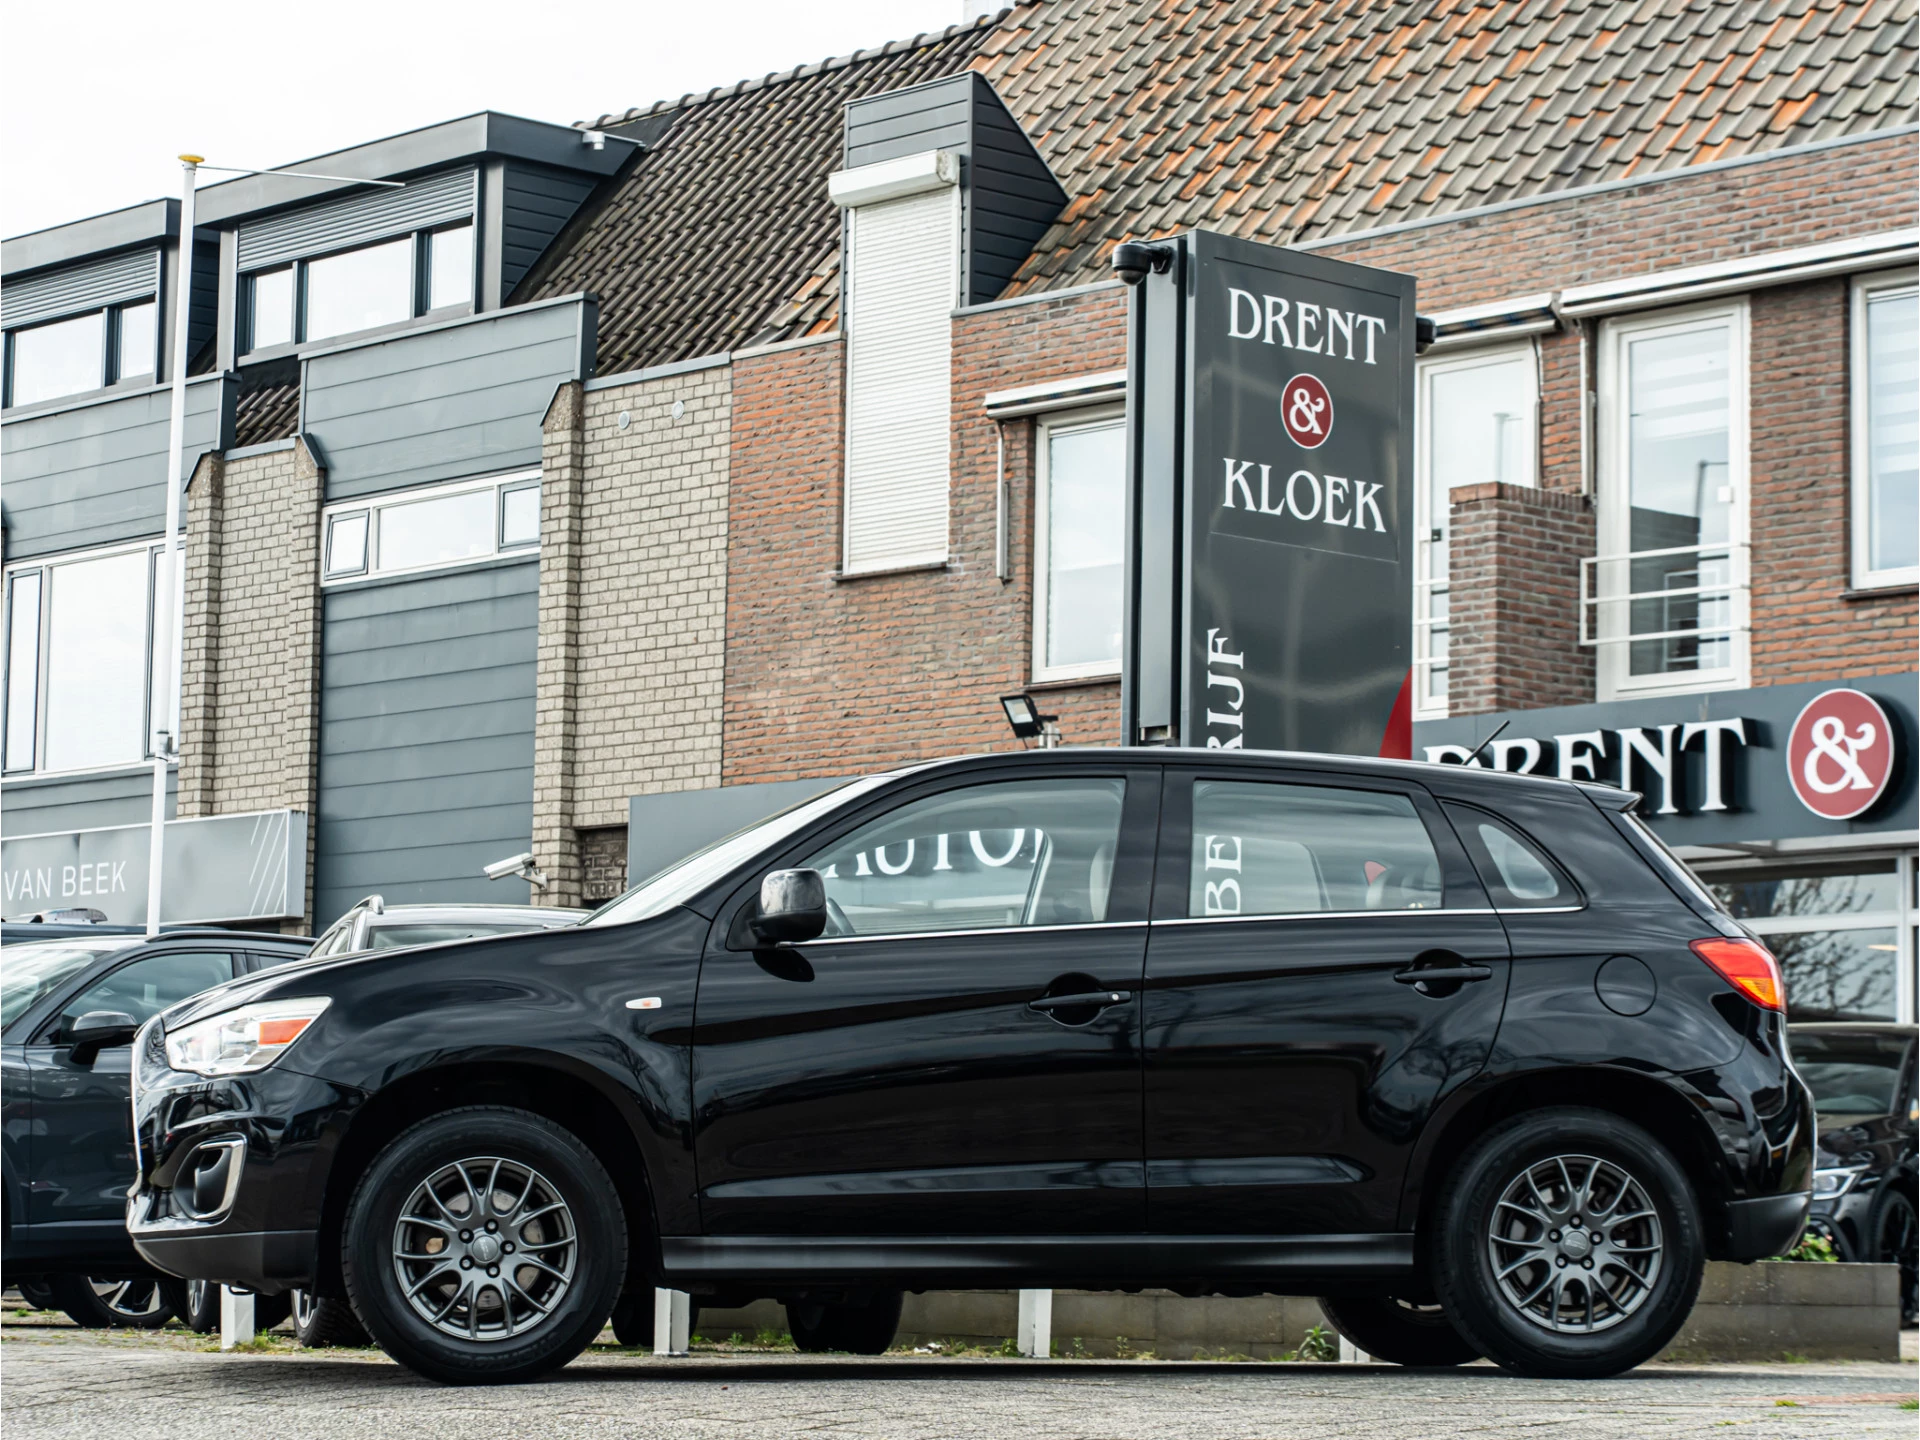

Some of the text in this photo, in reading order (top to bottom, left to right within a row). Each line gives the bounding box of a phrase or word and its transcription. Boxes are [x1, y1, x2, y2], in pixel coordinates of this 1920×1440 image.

[1227, 287, 1387, 365] DRENT
[1289, 388, 1325, 435] &
[1222, 457, 1387, 533] KLOEK
[1803, 715, 1876, 794] &
[4, 860, 127, 901] VAN BEEK
